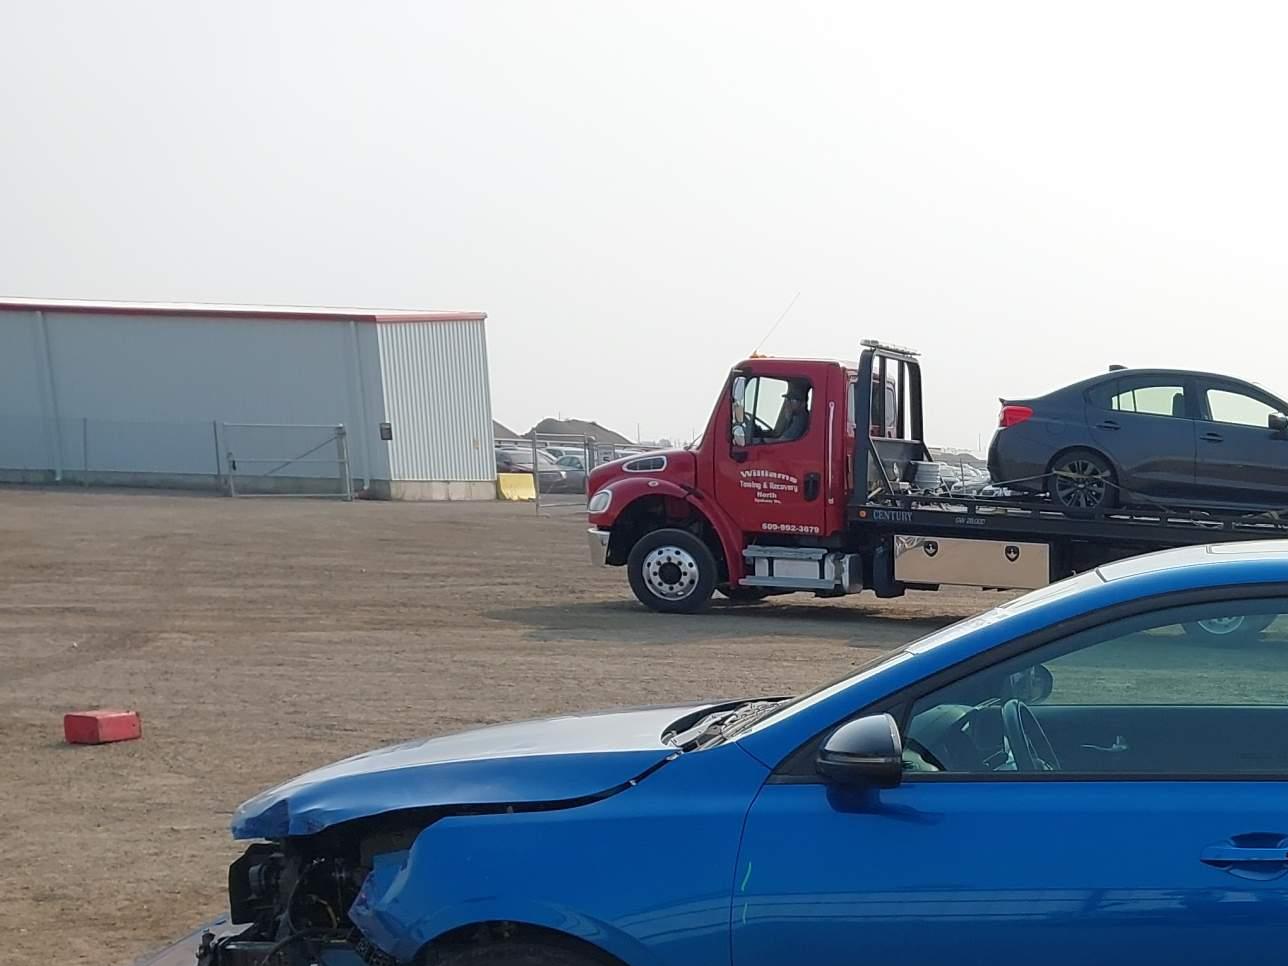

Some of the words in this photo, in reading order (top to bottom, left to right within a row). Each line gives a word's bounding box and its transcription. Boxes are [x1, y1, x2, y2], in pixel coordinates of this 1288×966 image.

[740, 470, 798, 484] Williams
[740, 480, 762, 490] Towing
[769, 482, 798, 493] Recovery
[757, 491, 777, 499] North
[873, 510, 912, 521] CENTURY
